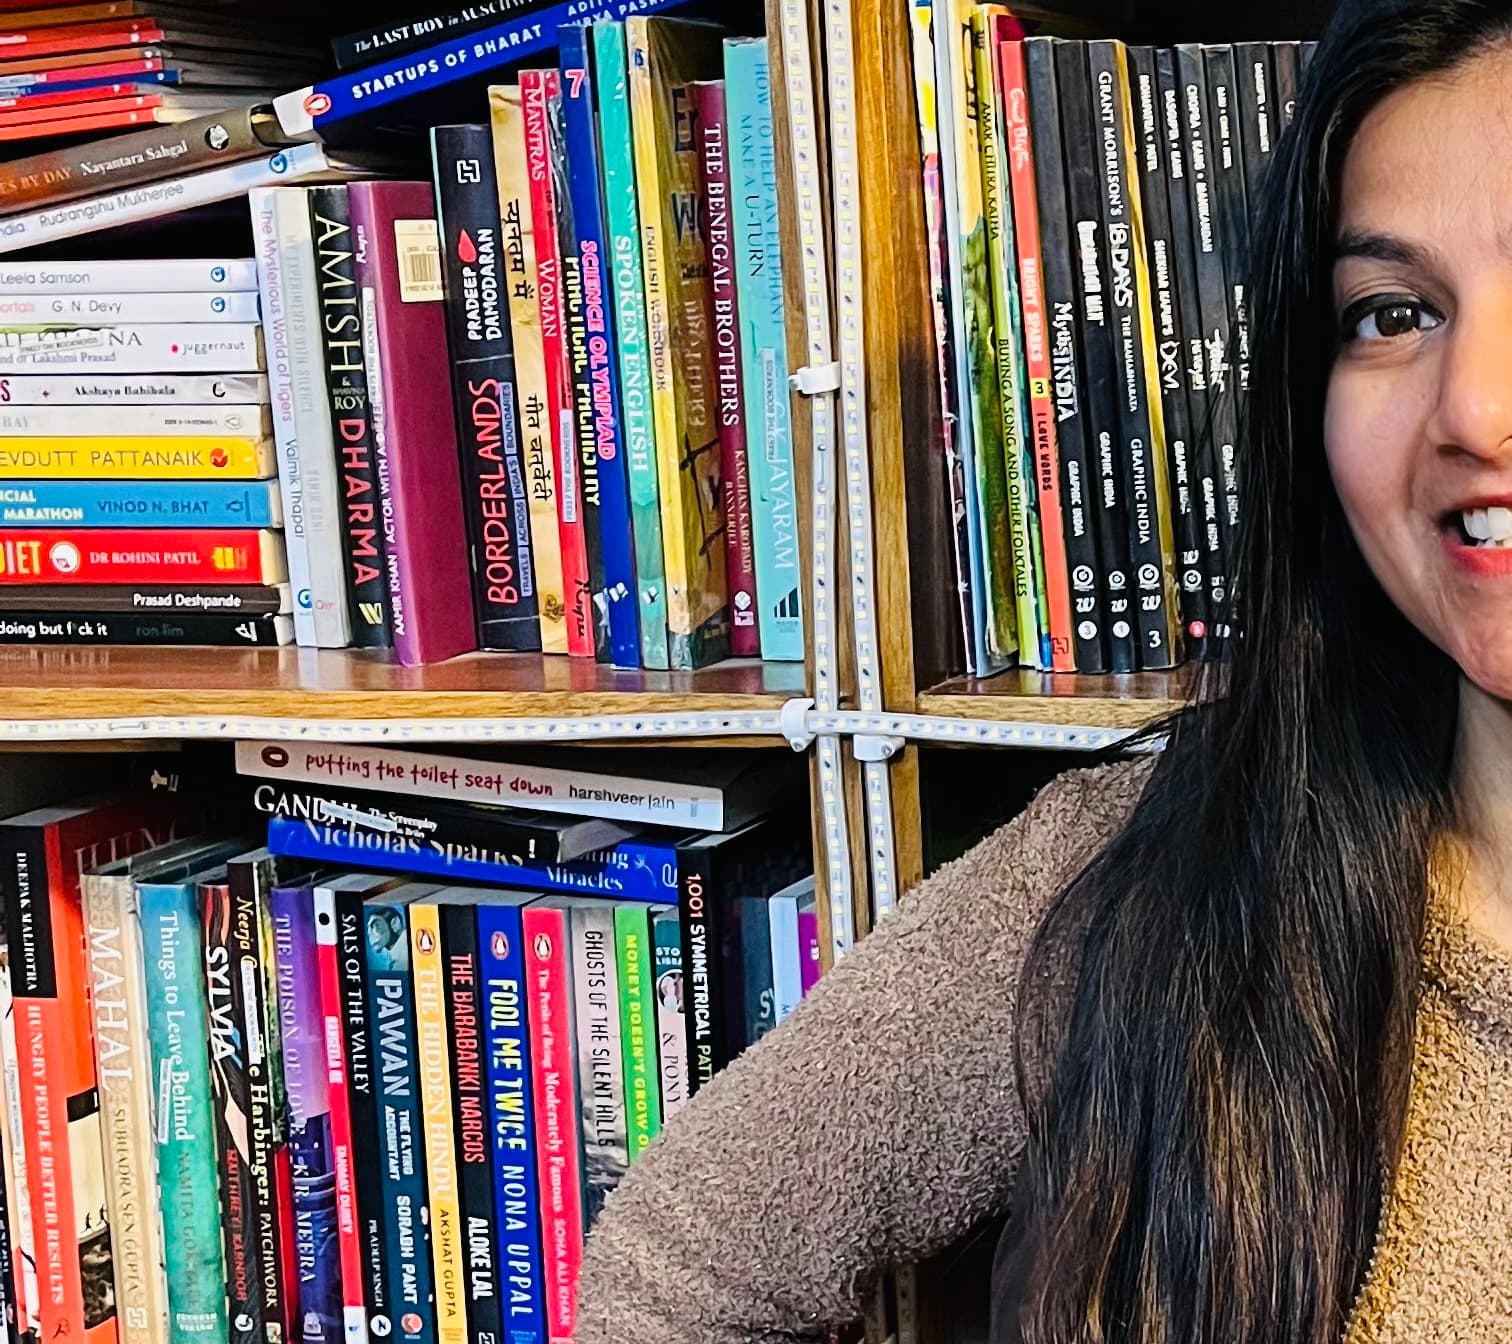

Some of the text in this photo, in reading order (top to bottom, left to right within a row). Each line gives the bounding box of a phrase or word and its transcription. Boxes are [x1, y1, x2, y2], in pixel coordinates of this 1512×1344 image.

[351, 24, 544, 99] STARTUPS OF BHARAT
[1098, 70, 1124, 217] GRANT MORRISON'S
[466, 227, 503, 343] PRADEEP DAMODARAN
[521, 88, 558, 338] MANTRAS WOMAN
[704, 123, 741, 427] THE BENEGAL BROTHERS
[316, 211, 378, 588] AMISH DHARMA
[614, 234, 652, 473] SPOKEN ENGLISH
[91, 449, 203, 468] PATTANAIK
[97, 499, 210, 515] VINOD BHAT
[474, 376, 519, 605] BORDERLANDS
[133, 592, 243, 609] Prasad Deshpande
[89, 923, 133, 1089] MAHAL
[158, 910, 194, 1141] Things Behind
[203, 943, 235, 1060] SYLVIA
[376, 976, 409, 1097] PAWAN
[686, 872, 711, 1040] 1,001 SYMMETRICAL
[455, 994, 493, 1301] BARABANKI NARCOS ALOKE LAL
[487, 976, 533, 1317] FOOL ME TWICE NONA UPPAL
